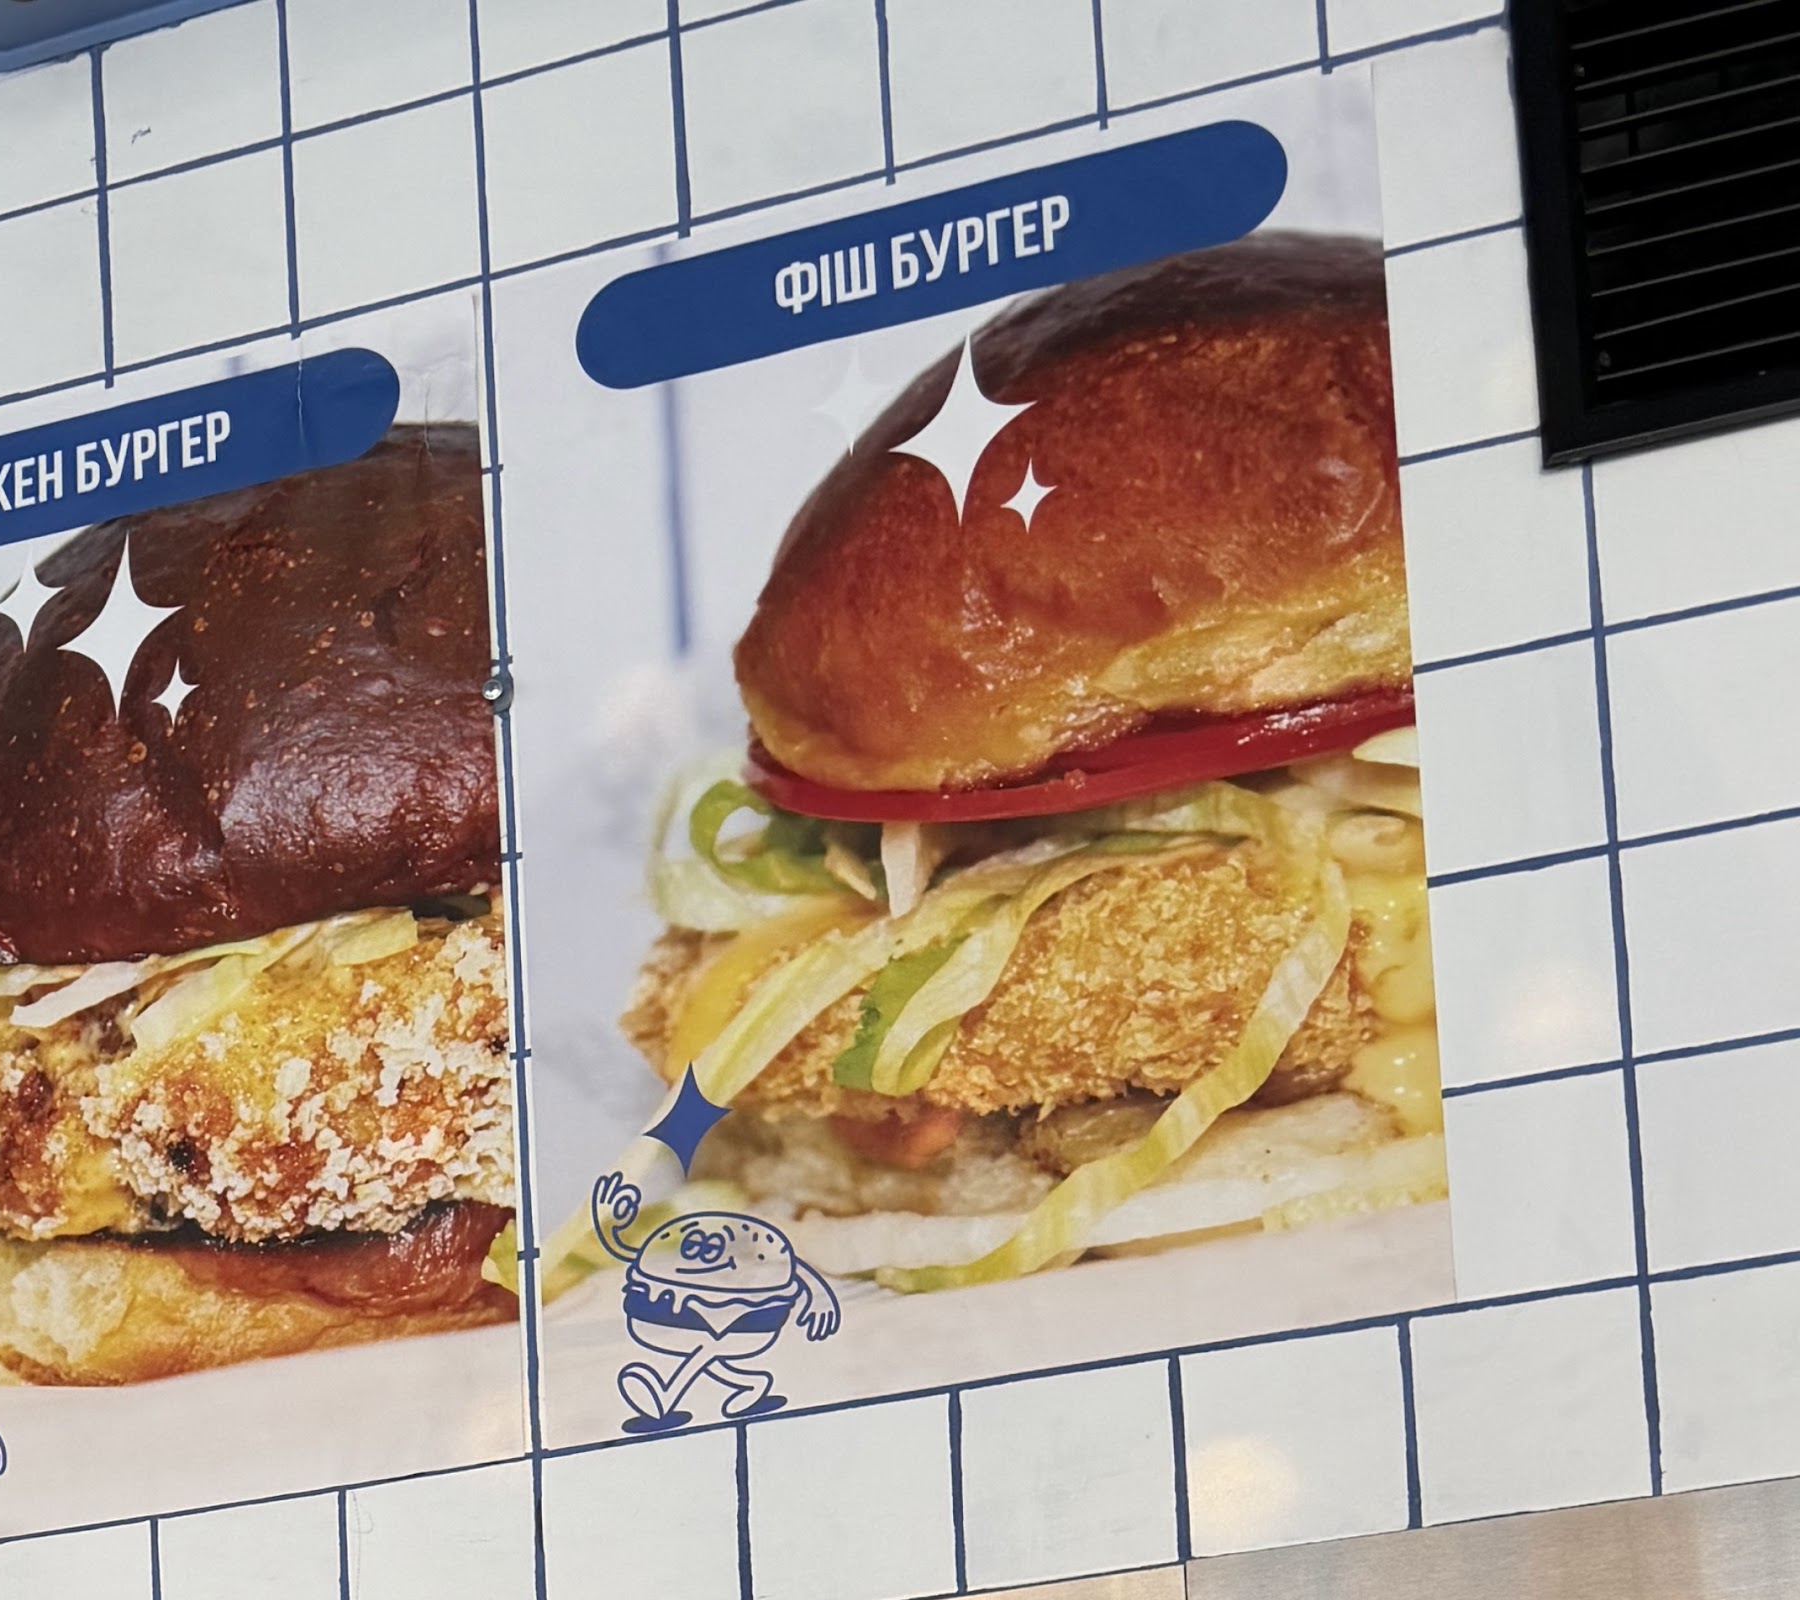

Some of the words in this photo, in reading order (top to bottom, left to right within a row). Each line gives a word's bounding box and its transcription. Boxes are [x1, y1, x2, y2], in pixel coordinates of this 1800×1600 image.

[776, 243, 876, 313] ФІШ
[891, 196, 1069, 289] БУРГЕР
[77, 411, 230, 493] БУРГЕР
